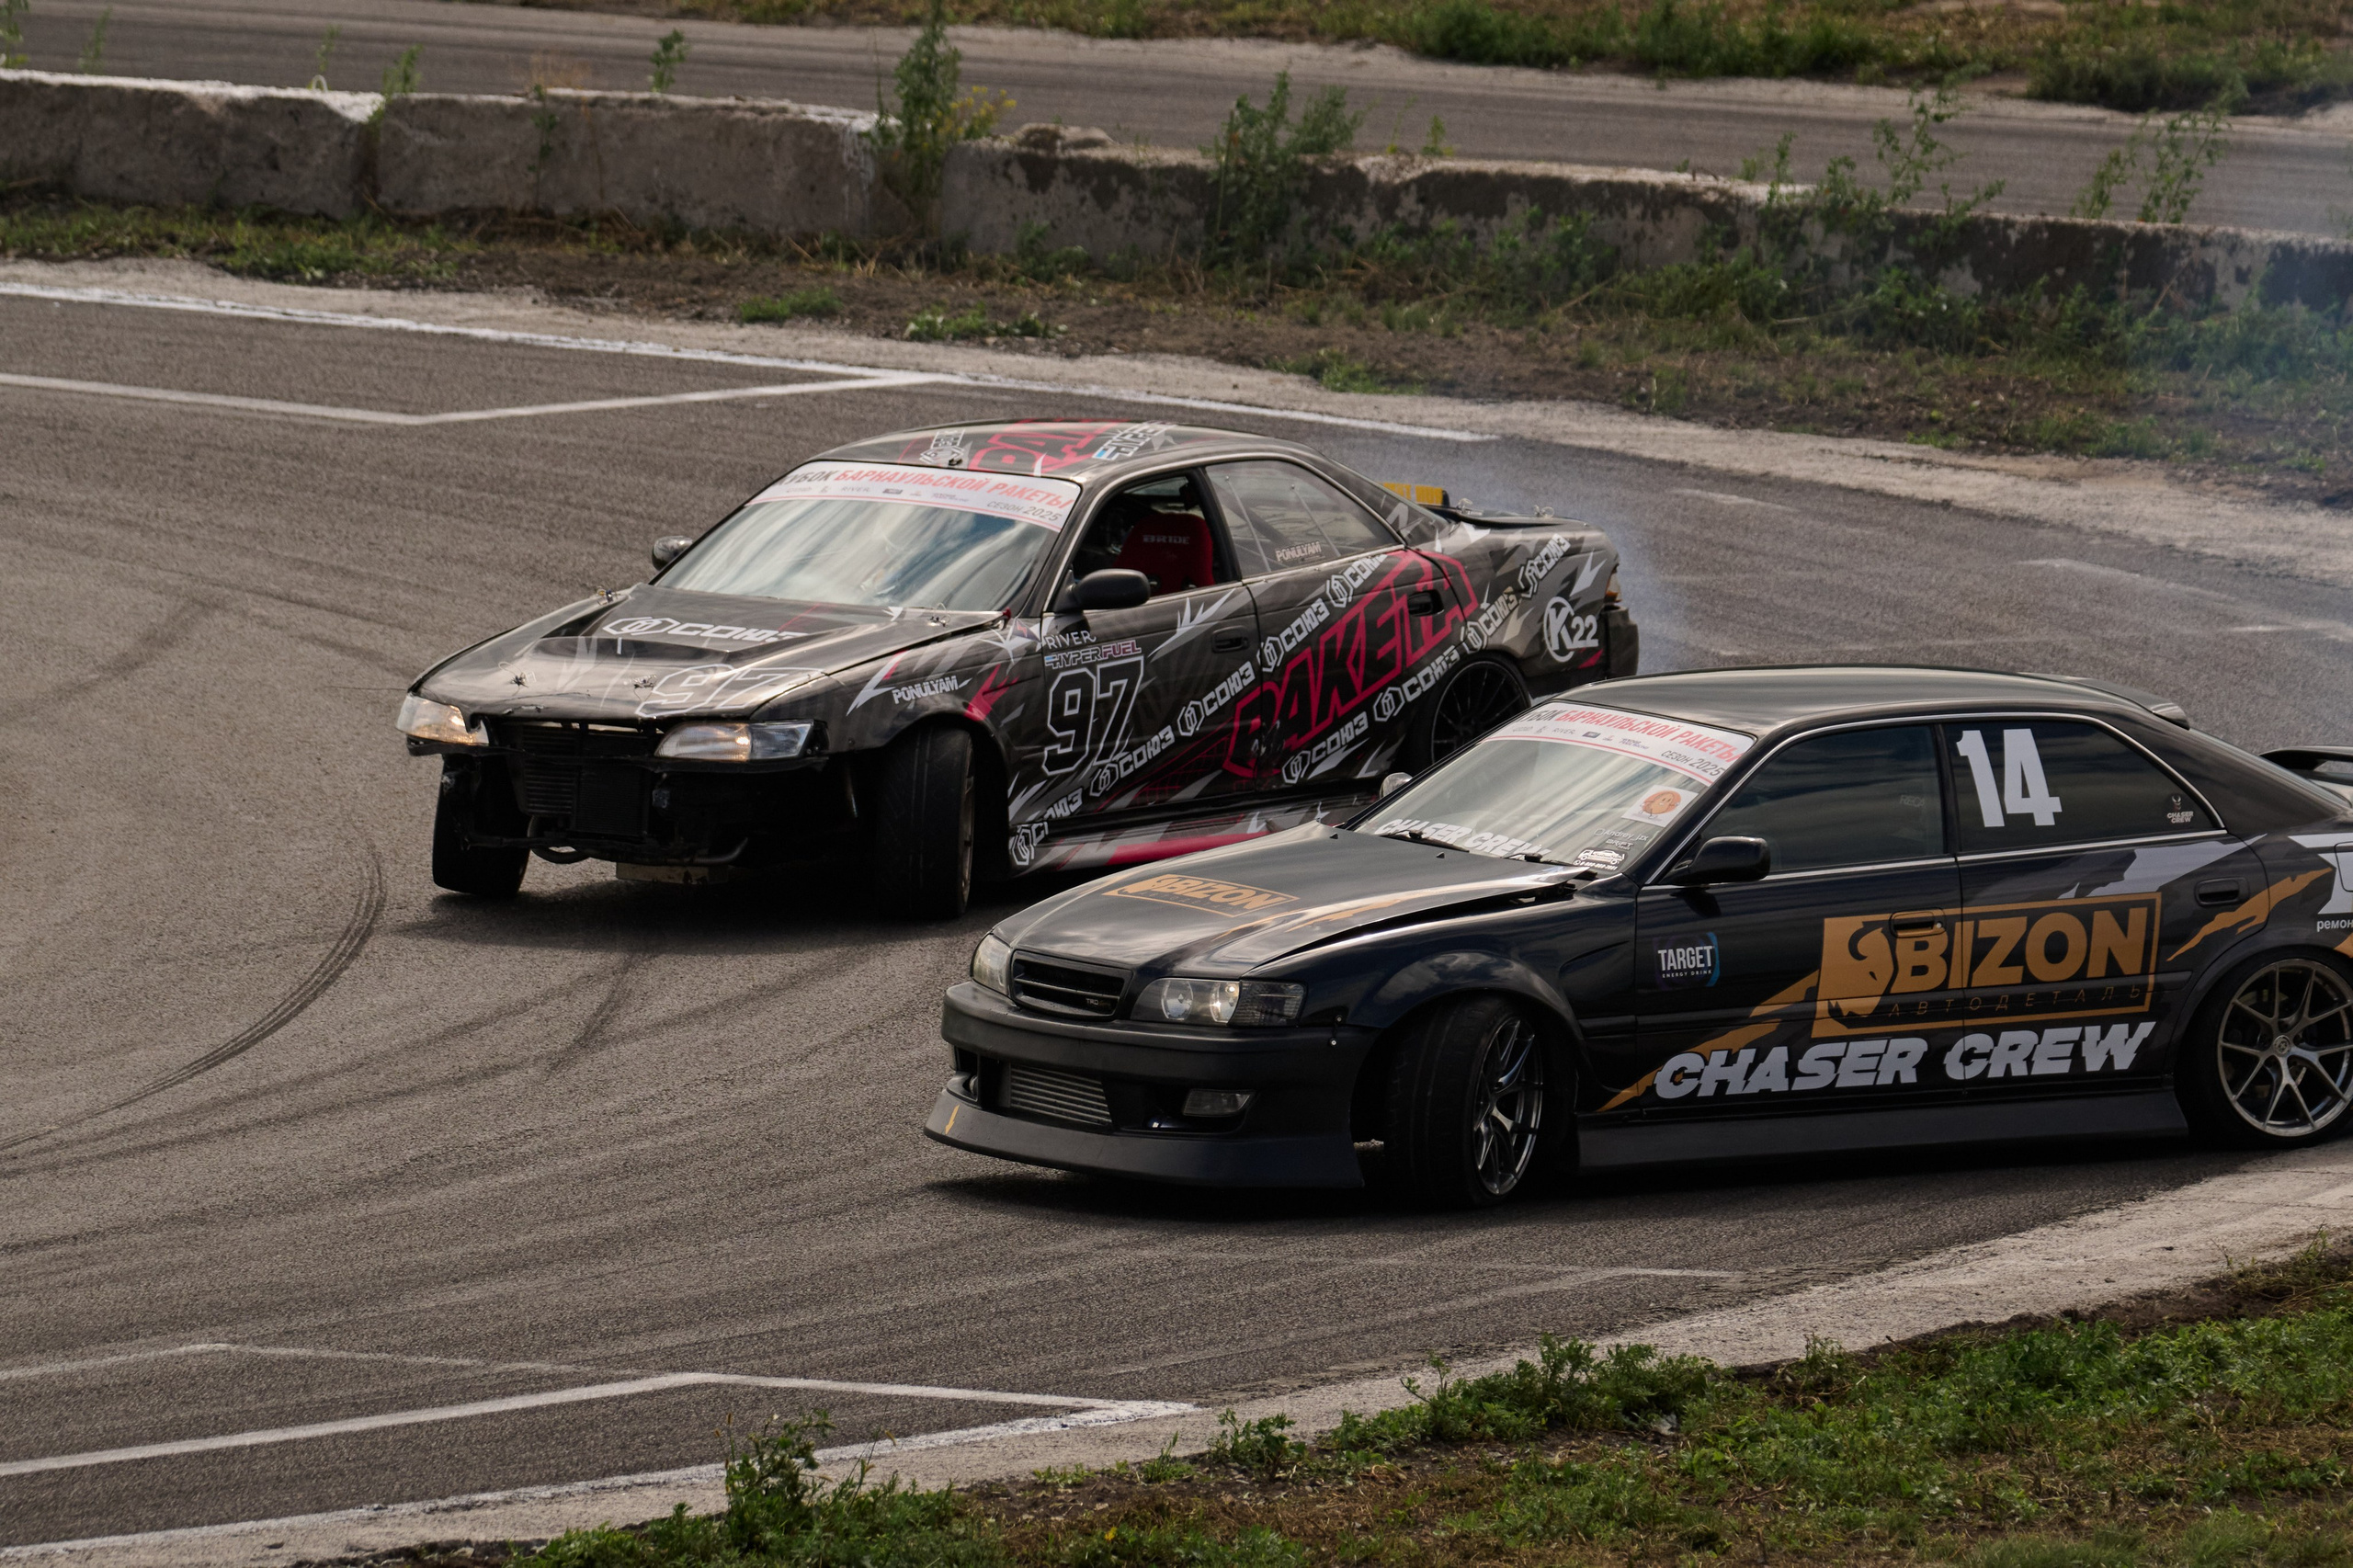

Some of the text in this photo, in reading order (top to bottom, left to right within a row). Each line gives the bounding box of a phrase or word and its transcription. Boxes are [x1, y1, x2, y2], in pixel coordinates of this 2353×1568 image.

[835, 470, 989, 492] БАРНАУЛЬСКОЙ
[986, 483, 1074, 508] РАКЕТЫ
[987, 501, 1063, 521] СЕЗОН 2025
[1142, 534, 1191, 544] BRIDE
[1534, 533, 1572, 579] СОЮЗ
[1044, 631, 1097, 650] RIVER
[1281, 598, 1330, 647] СОЮЗ
[634, 664, 825, 718] 97
[892, 676, 959, 704] PONULYAM
[1203, 661, 1256, 717] СОЮЗ
[1403, 645, 1461, 702] СОЮЗ
[1041, 655, 1144, 776] 97
[1311, 711, 1369, 764] СОЮЗ
[1518, 710, 1566, 723] УБОК
[1554, 710, 1681, 739] БАРНАУЛЬСКОЙ
[1120, 725, 1175, 778] СОЮЗ
[1661, 750, 1725, 776] СЕЗОН 2025
[1956, 728, 2063, 827] 14
[1149, 878, 1286, 910] BIZON
[1657, 945, 1713, 971] TARGET
[1890, 907, 2149, 994] BIZON
[1654, 1021, 2156, 1099] CHASER CREW
